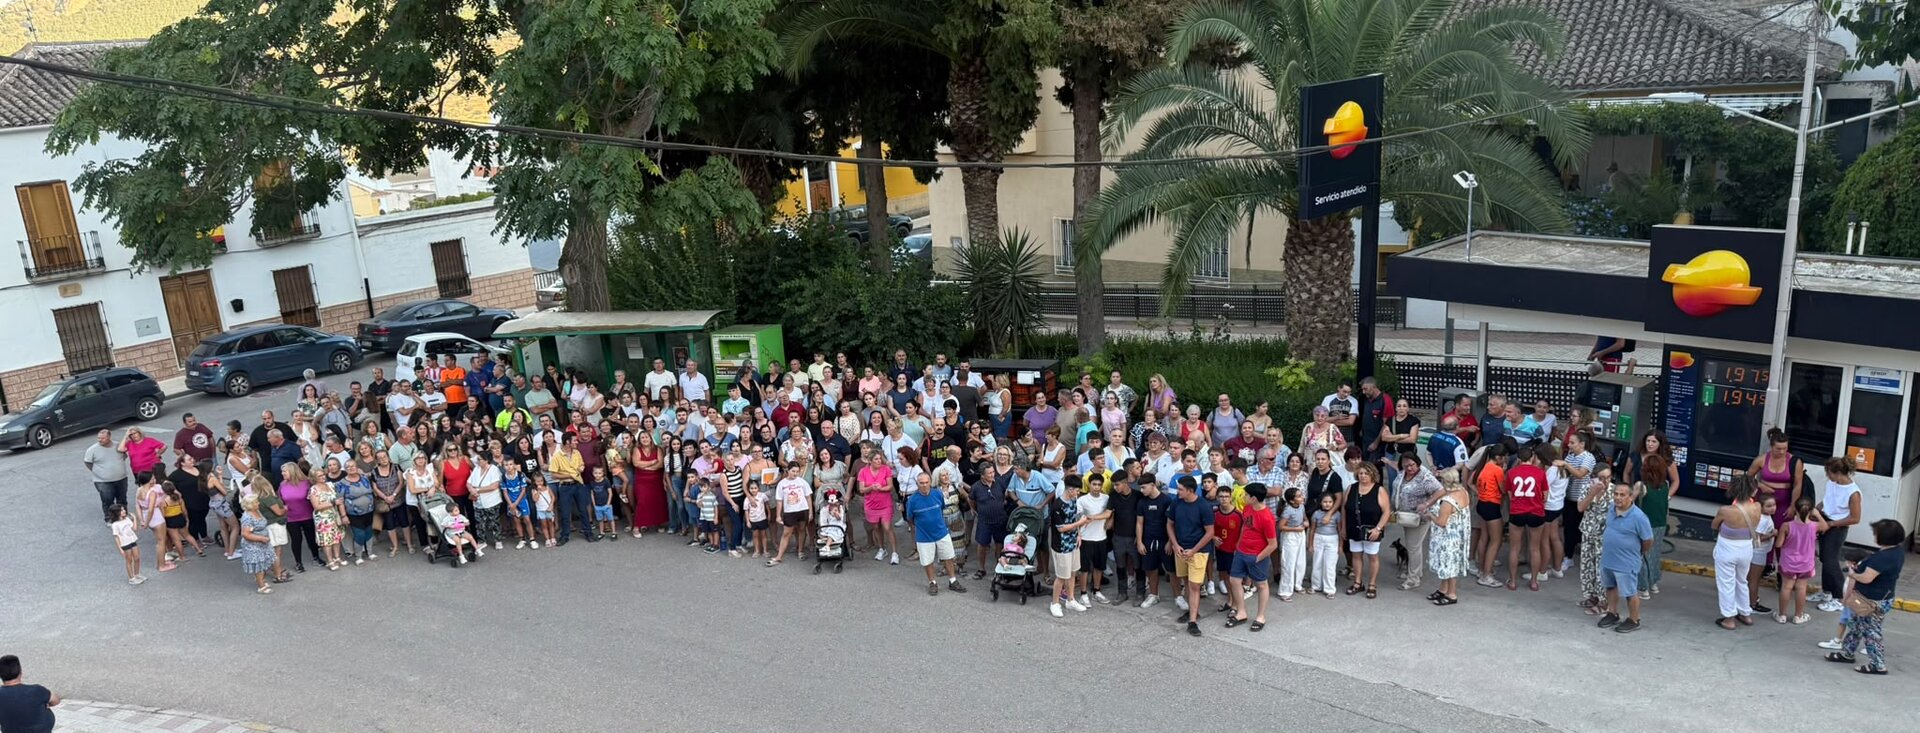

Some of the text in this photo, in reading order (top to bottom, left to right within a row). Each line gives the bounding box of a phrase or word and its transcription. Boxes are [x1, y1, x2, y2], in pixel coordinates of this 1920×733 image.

[1315, 185, 1366, 205] Servicio atendido
[1513, 476, 1535, 497] 22
[1221, 528, 1228, 539] 9
